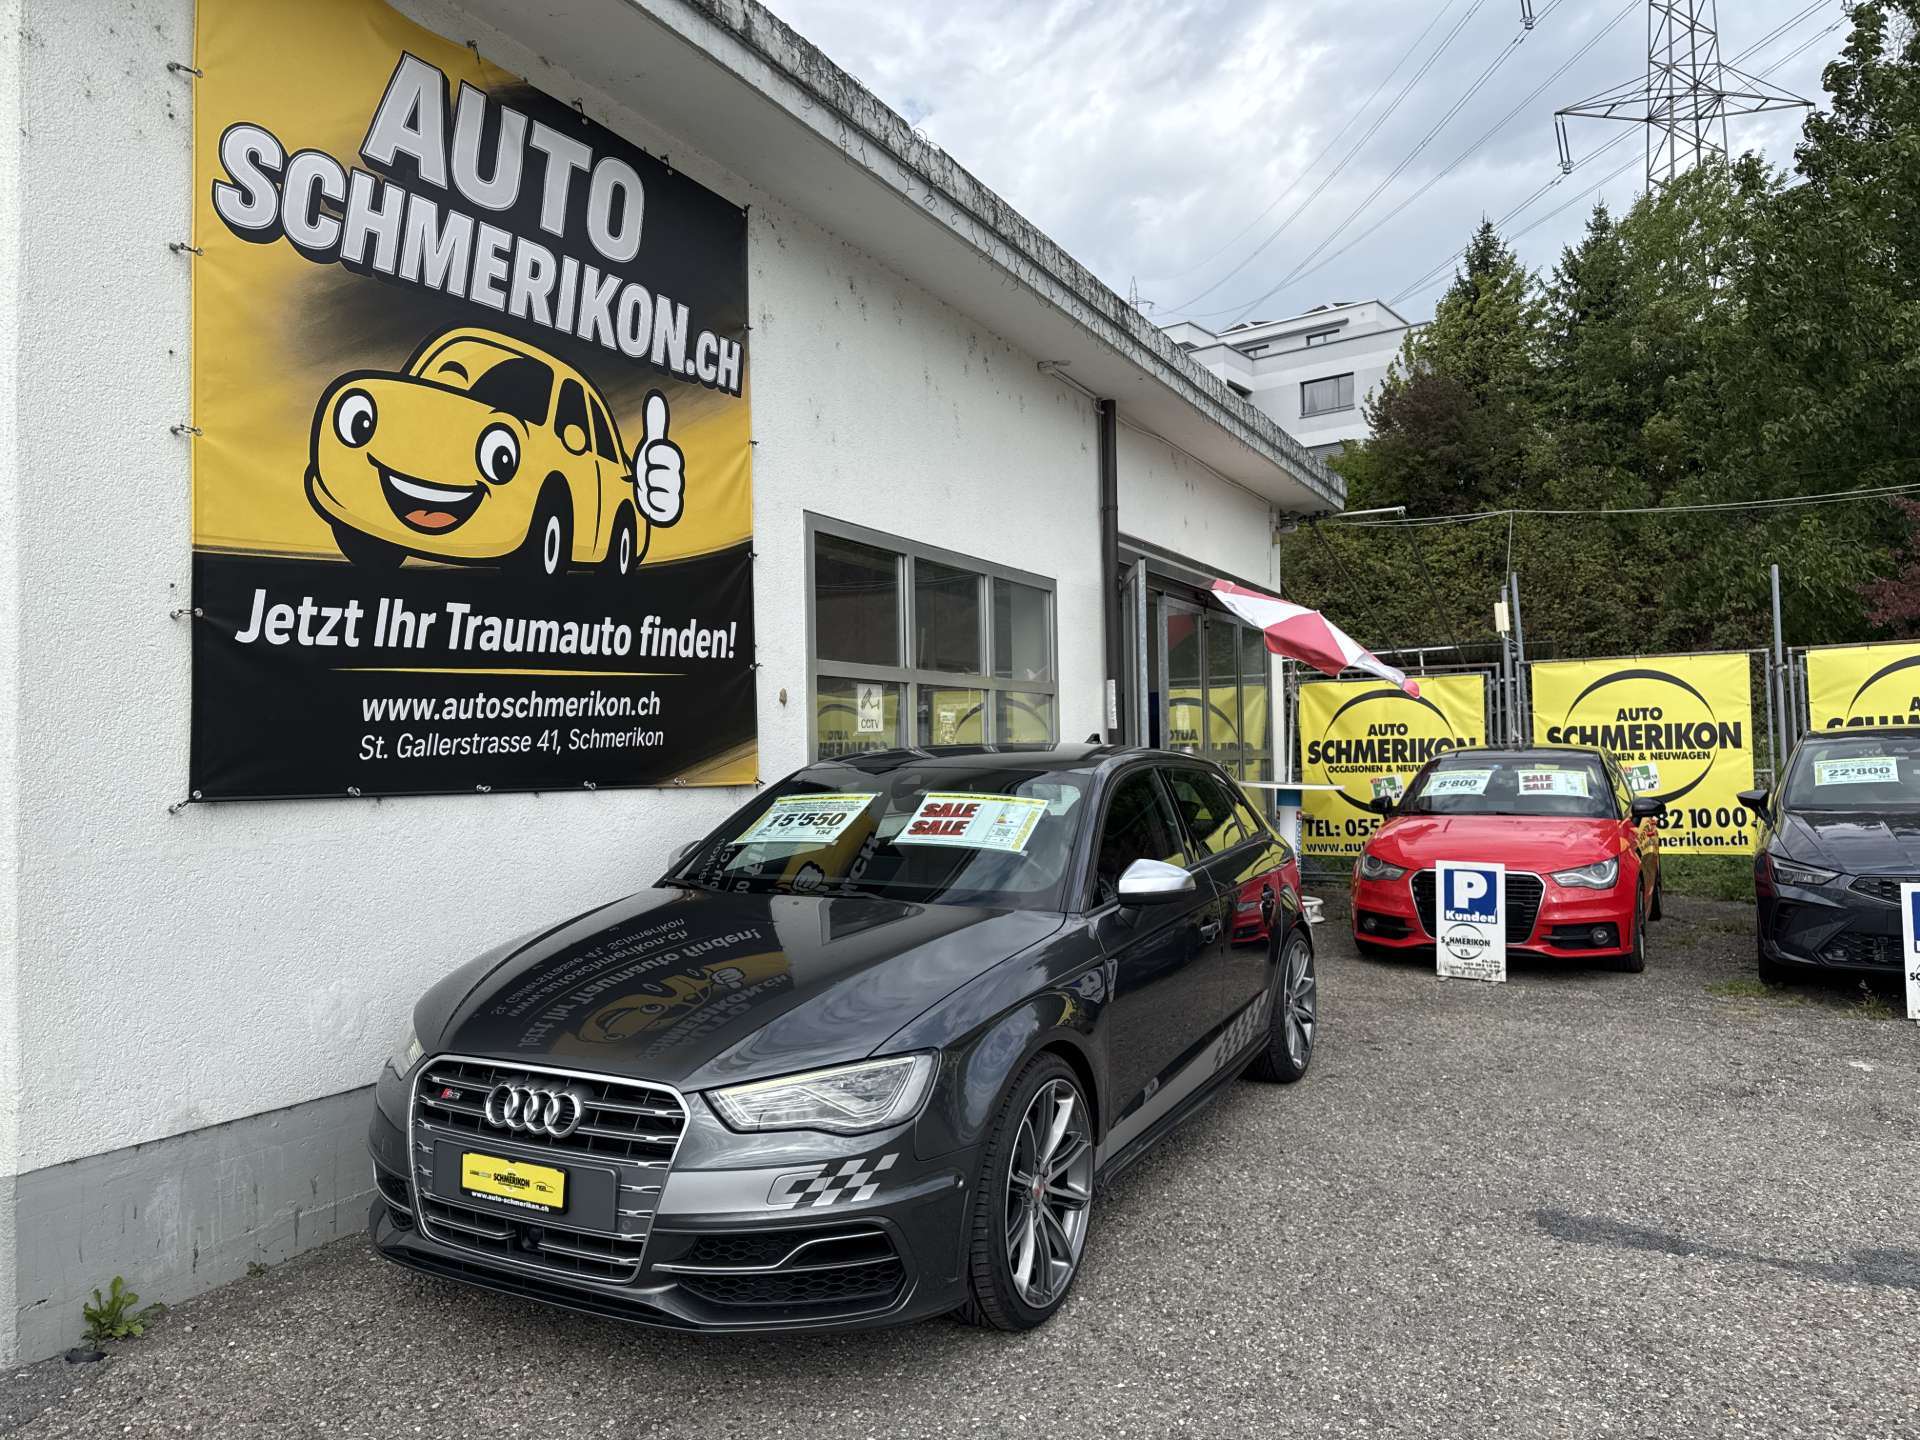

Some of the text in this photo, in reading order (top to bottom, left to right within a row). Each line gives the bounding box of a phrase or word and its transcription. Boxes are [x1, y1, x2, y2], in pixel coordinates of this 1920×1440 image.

[361, 50, 645, 263] AUTO
[213, 123, 743, 392] SCHMERIKON.CH
[235, 588, 737, 659] Jetzt Ihr Traumauto finden!
[362, 689, 661, 722] www.autoschmerikon.ch
[1616, 706, 1663, 721] AUTO
[860, 718, 879, 729] CCTV
[1367, 724, 1408, 736] AUTO
[358, 727, 664, 761] St. Gallerstrasse 41, Schmerikon
[1547, 722, 1742, 751] SCHMERIKON
[1638, 752, 1646, 761] &
[1650, 751, 1711, 761] NEUWAGEN
[1328, 765, 1424, 773] OCCASIONEN & NEUW
[1828, 767, 1891, 777] 22'800
[1522, 775, 1552, 783] SALE
[1523, 783, 1553, 791] SALE
[920, 803, 981, 817] SALE
[768, 812, 848, 827] 15'550
[1656, 807, 1747, 829] 82 10 00
[908, 820, 970, 835] SALE
[1305, 819, 1341, 837] TEL:
[1453, 871, 1488, 909] P
[1446, 909, 1497, 924] Kunden
[493, 1172, 530, 1188] SCHMERIKON
